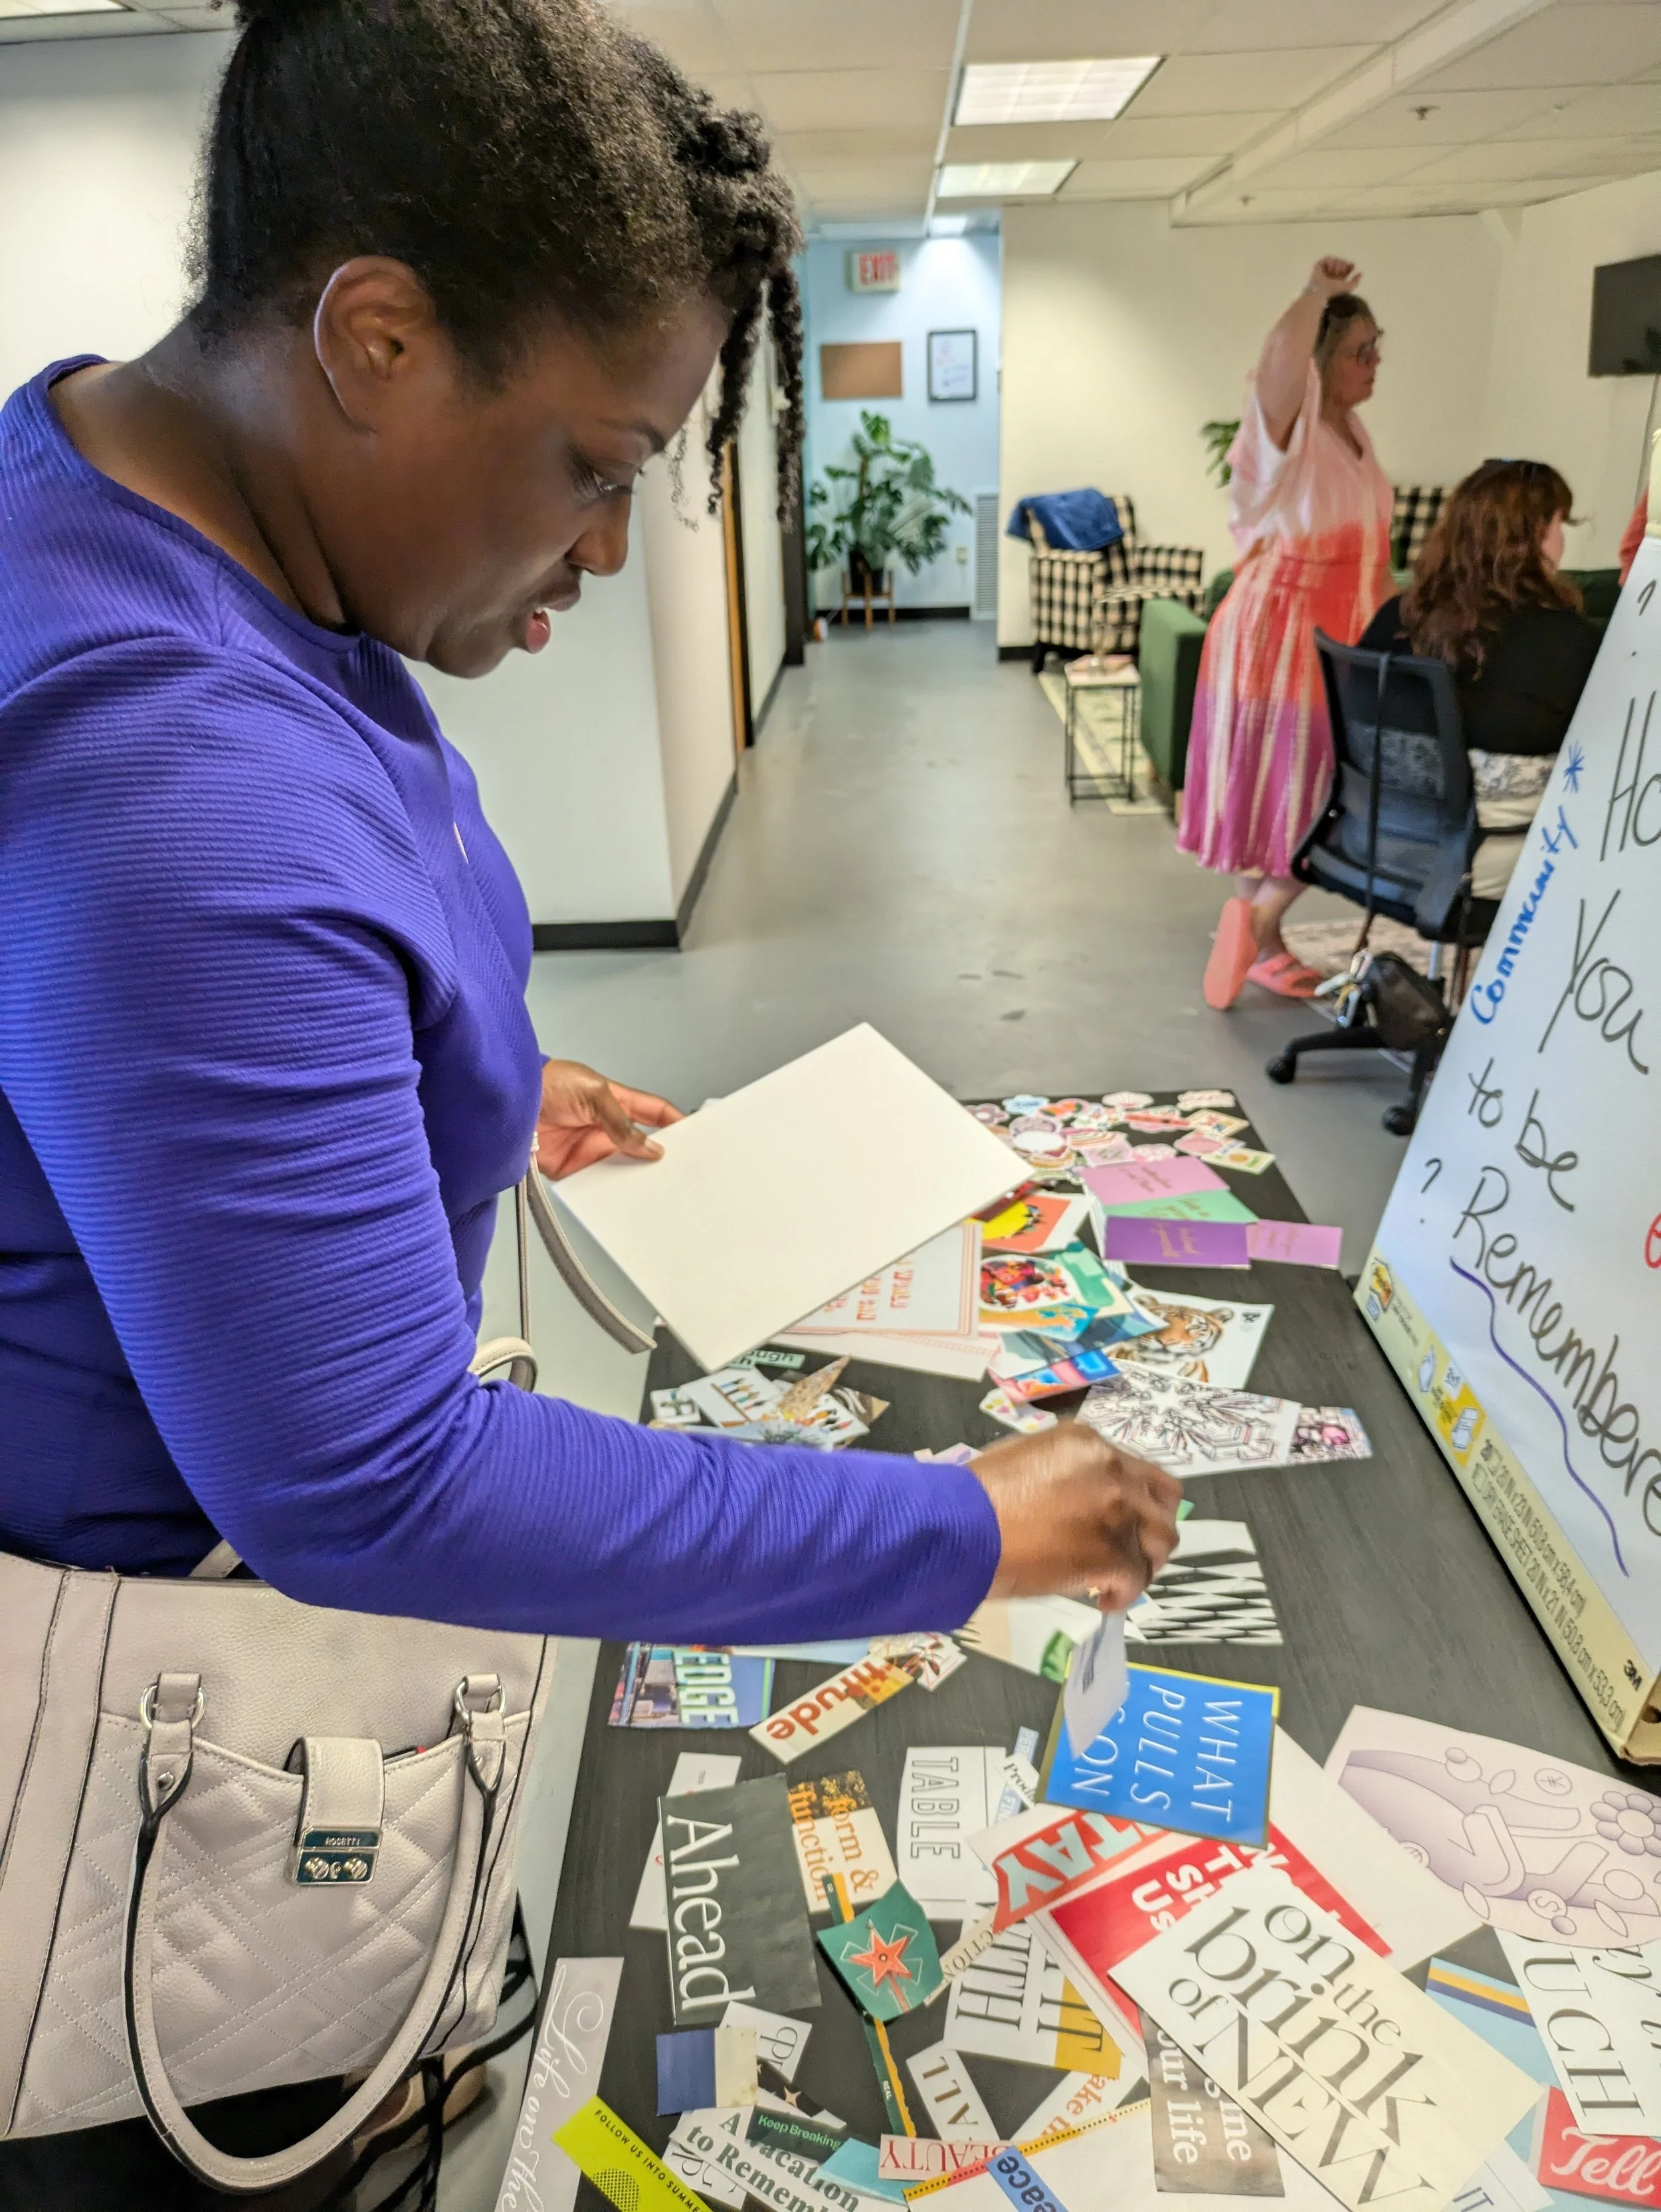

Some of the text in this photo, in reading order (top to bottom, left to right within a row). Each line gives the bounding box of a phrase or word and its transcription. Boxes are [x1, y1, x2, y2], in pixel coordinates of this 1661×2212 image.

[860, 253, 896, 285] EXIT
[1470, 805, 1579, 1026] Community
[1537, 889, 1650, 1074] You
[1467, 1057, 1579, 1212] to be
[673, 1650, 740, 1726] EDGE
[766, 1656, 904, 1740] titude
[1622, 1658, 1642, 1692] 3M
[1129, 1684, 1187, 1811] PULLS
[1191, 1700, 1243, 1823] WHAT
[824, 1797, 880, 1894] form &
[911, 1757, 961, 1860] TABLE
[997, 1811, 1149, 1912] TAY
[666, 1815, 757, 2013] Ahead
[1264, 1904, 1356, 1988] on
[1332, 1982, 1403, 2047] the
[1184, 1906, 1438, 2148] brink
[1521, 1944, 1646, 2118] UCH
[686, 2126, 714, 2152] to
[719, 2112, 742, 2136] A
[758, 2114, 842, 2150] Keep Breaking
[922, 2056, 979, 2126] ALL
[1066, 2072, 1108, 2116] ake
[1166, 2100, 1207, 2165] life
[1168, 1977, 1440, 2205] of NEW
[595, 2109, 631, 2145] FOLLOW
[630, 2144, 644, 2158] US
[642, 2158, 666, 2181] INTO
[1551, 2126, 1661, 2196] Tell
